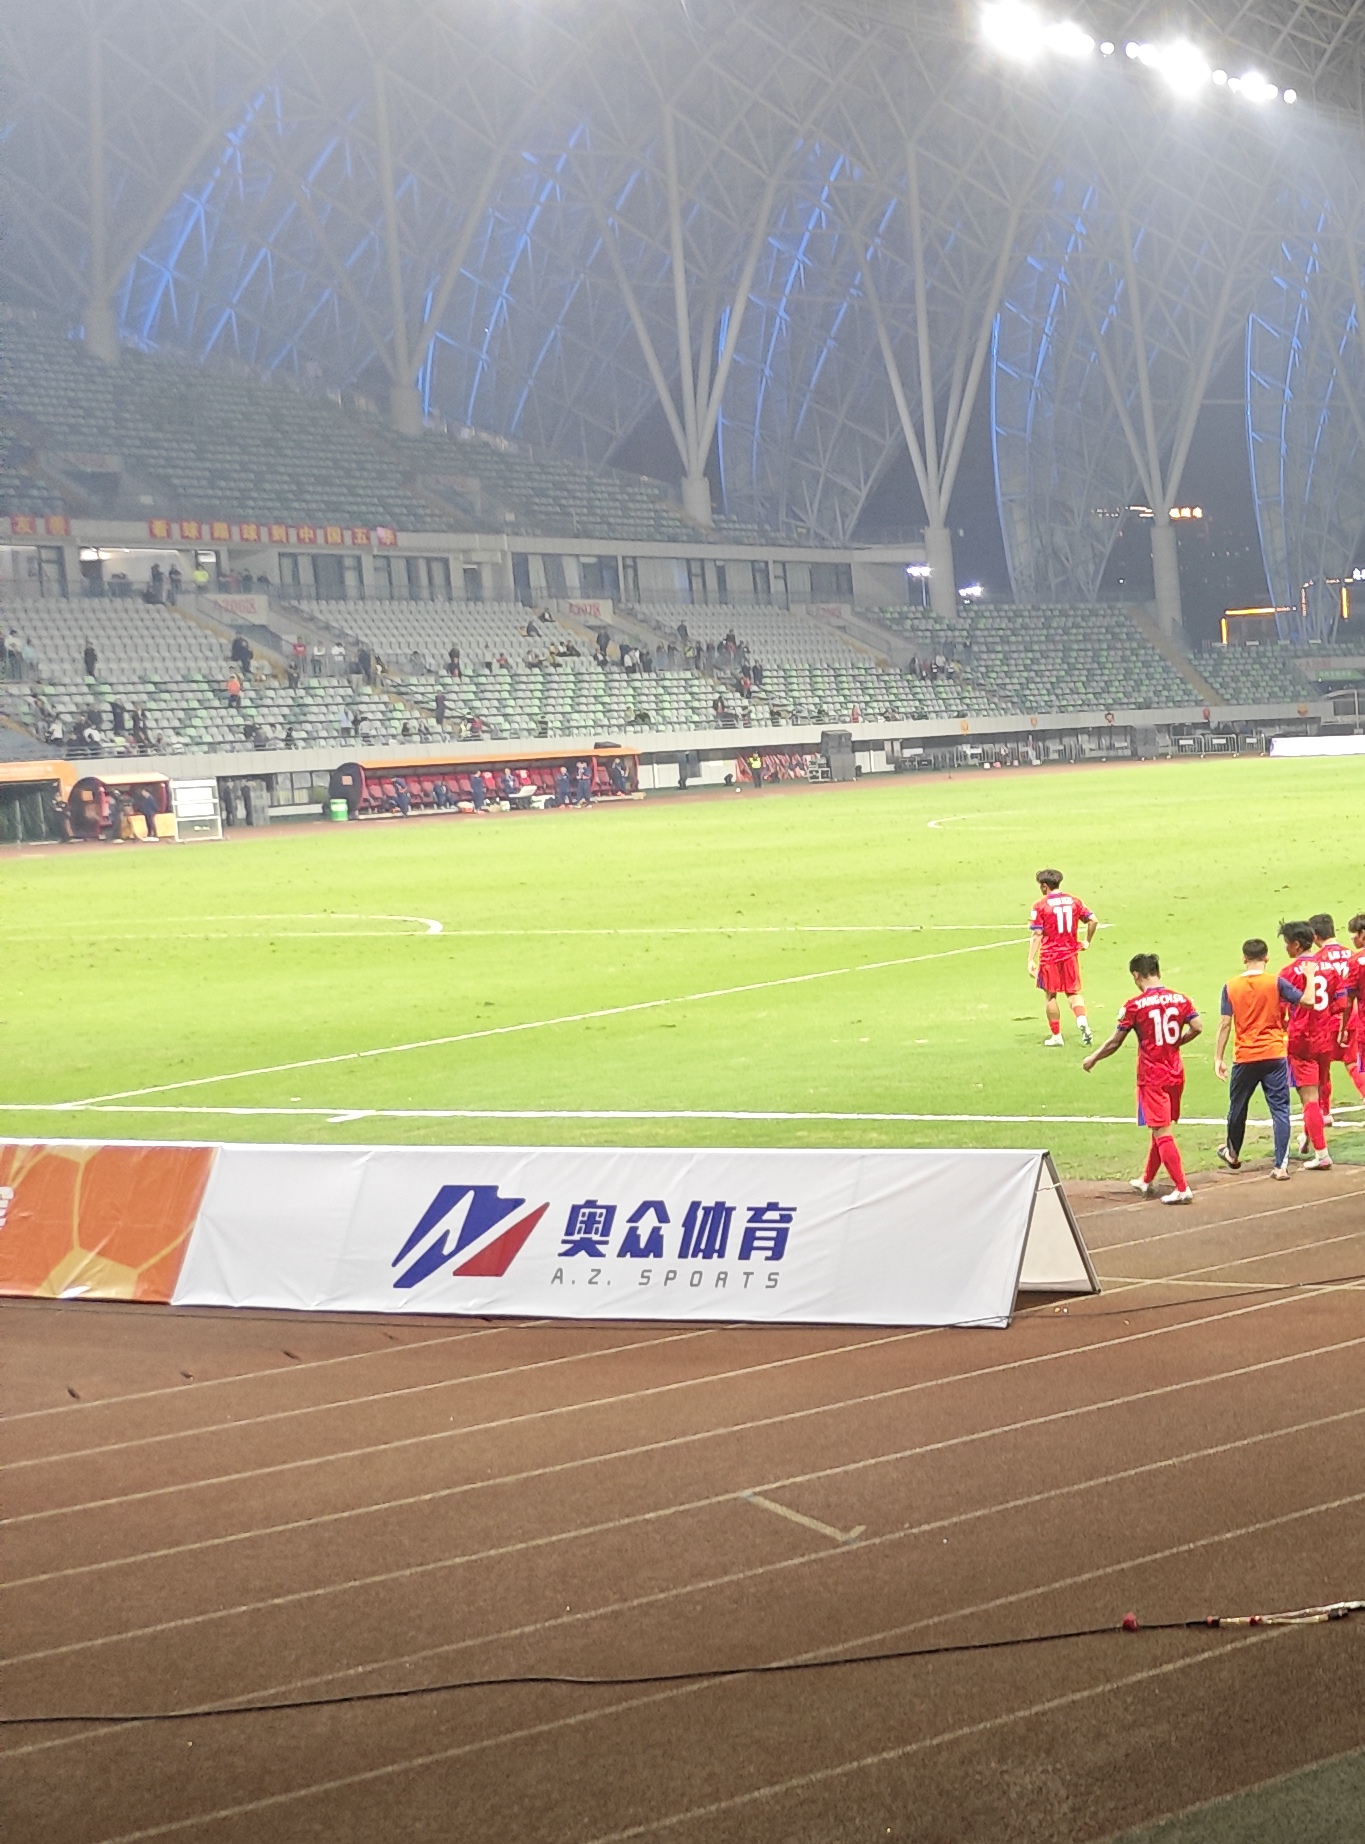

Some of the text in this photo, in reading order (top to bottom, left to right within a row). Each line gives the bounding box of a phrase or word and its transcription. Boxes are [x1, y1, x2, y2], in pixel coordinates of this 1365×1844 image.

[1053, 905, 1073, 934] 11
[1148, 1006, 1180, 1046] 16
[557, 1199, 797, 1261] 奥众体育
[550, 1267, 780, 1289] A.Z. SPORTS
